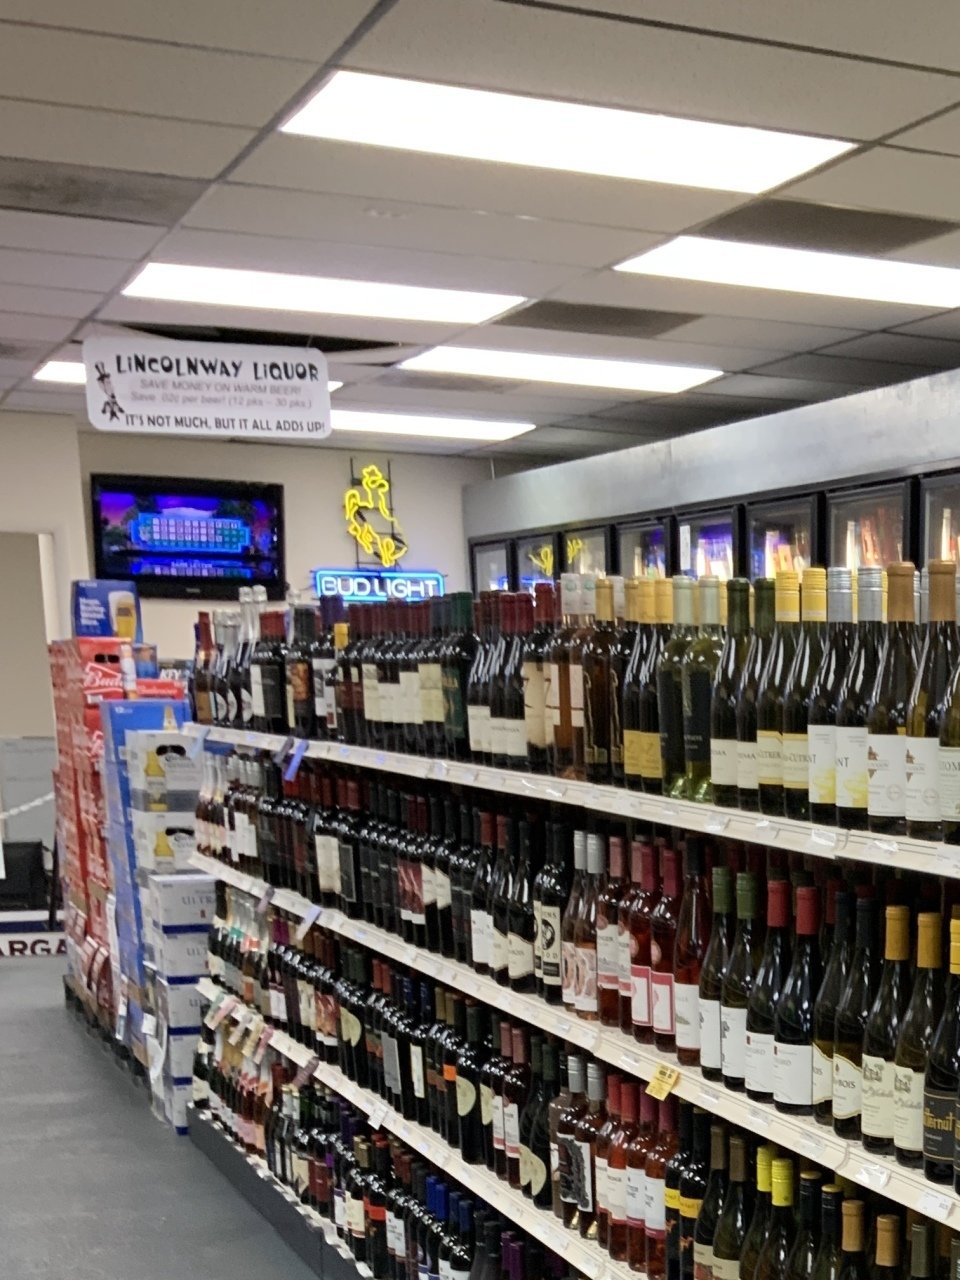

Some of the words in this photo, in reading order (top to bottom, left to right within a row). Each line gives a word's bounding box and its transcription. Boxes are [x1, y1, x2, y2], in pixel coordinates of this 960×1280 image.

[140, 379, 167, 390] SAVE
[172, 380, 211, 391] MONEY
[214, 382, 231, 393] ON
[233, 382, 267, 394] WARM
[125, 413, 145, 426] IT'S
[147, 415, 170, 427] NOT
[215, 417, 236, 430] BUT
[239, 418, 248, 430] IT
[252, 419, 271, 431] ALL
[275, 420, 304, 432] ADDS
[321, 576, 371, 597] BUD
[373, 578, 438, 598] LIGHT
